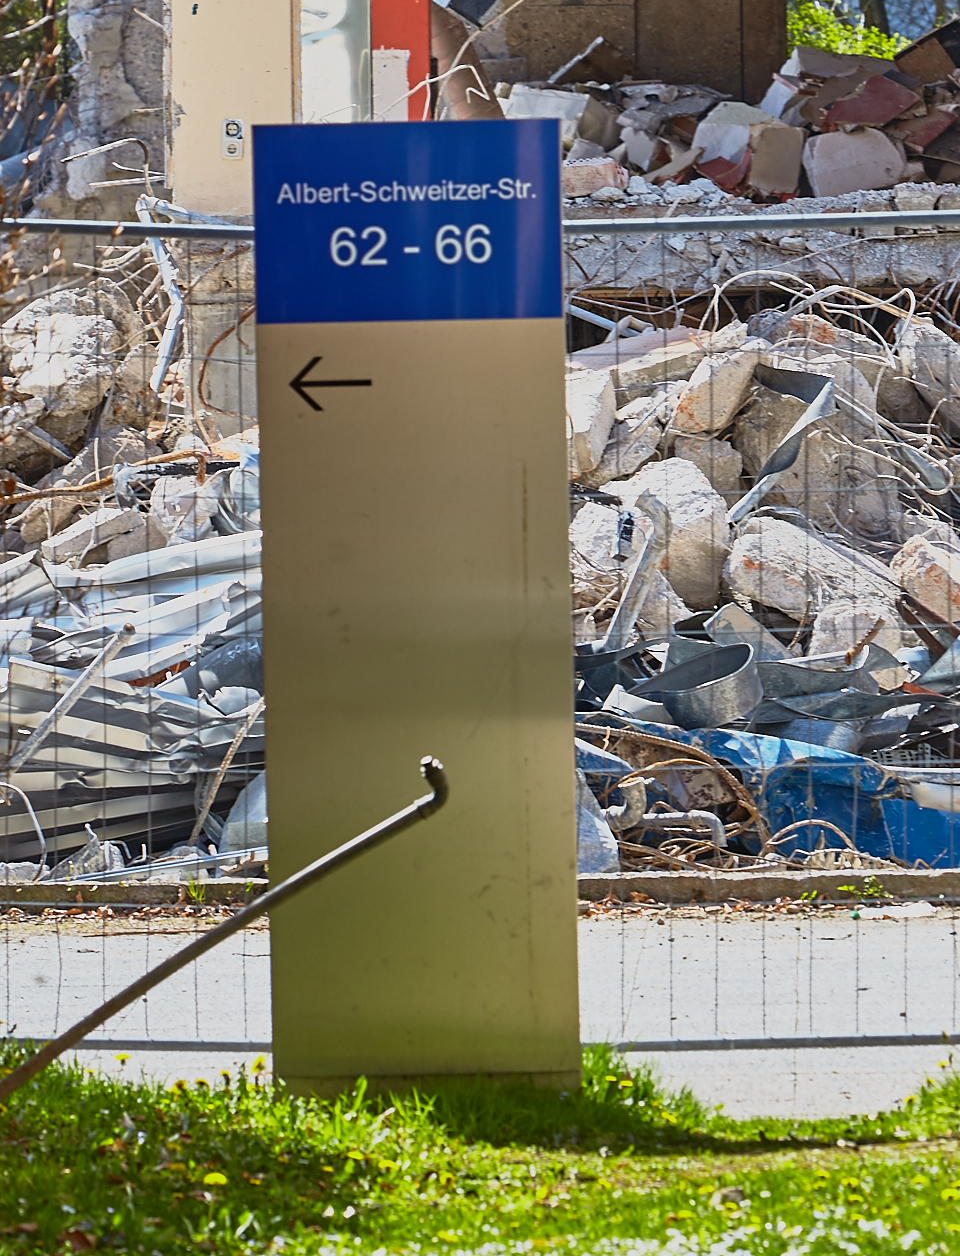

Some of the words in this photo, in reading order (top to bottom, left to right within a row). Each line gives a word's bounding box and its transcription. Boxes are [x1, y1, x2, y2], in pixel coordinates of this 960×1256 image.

[277, 178, 536, 204] Albert-Schweitzer-Str.
[330, 226, 388, 266] 62
[403, 246, 420, 254] -
[435, 224, 492, 265] 66
